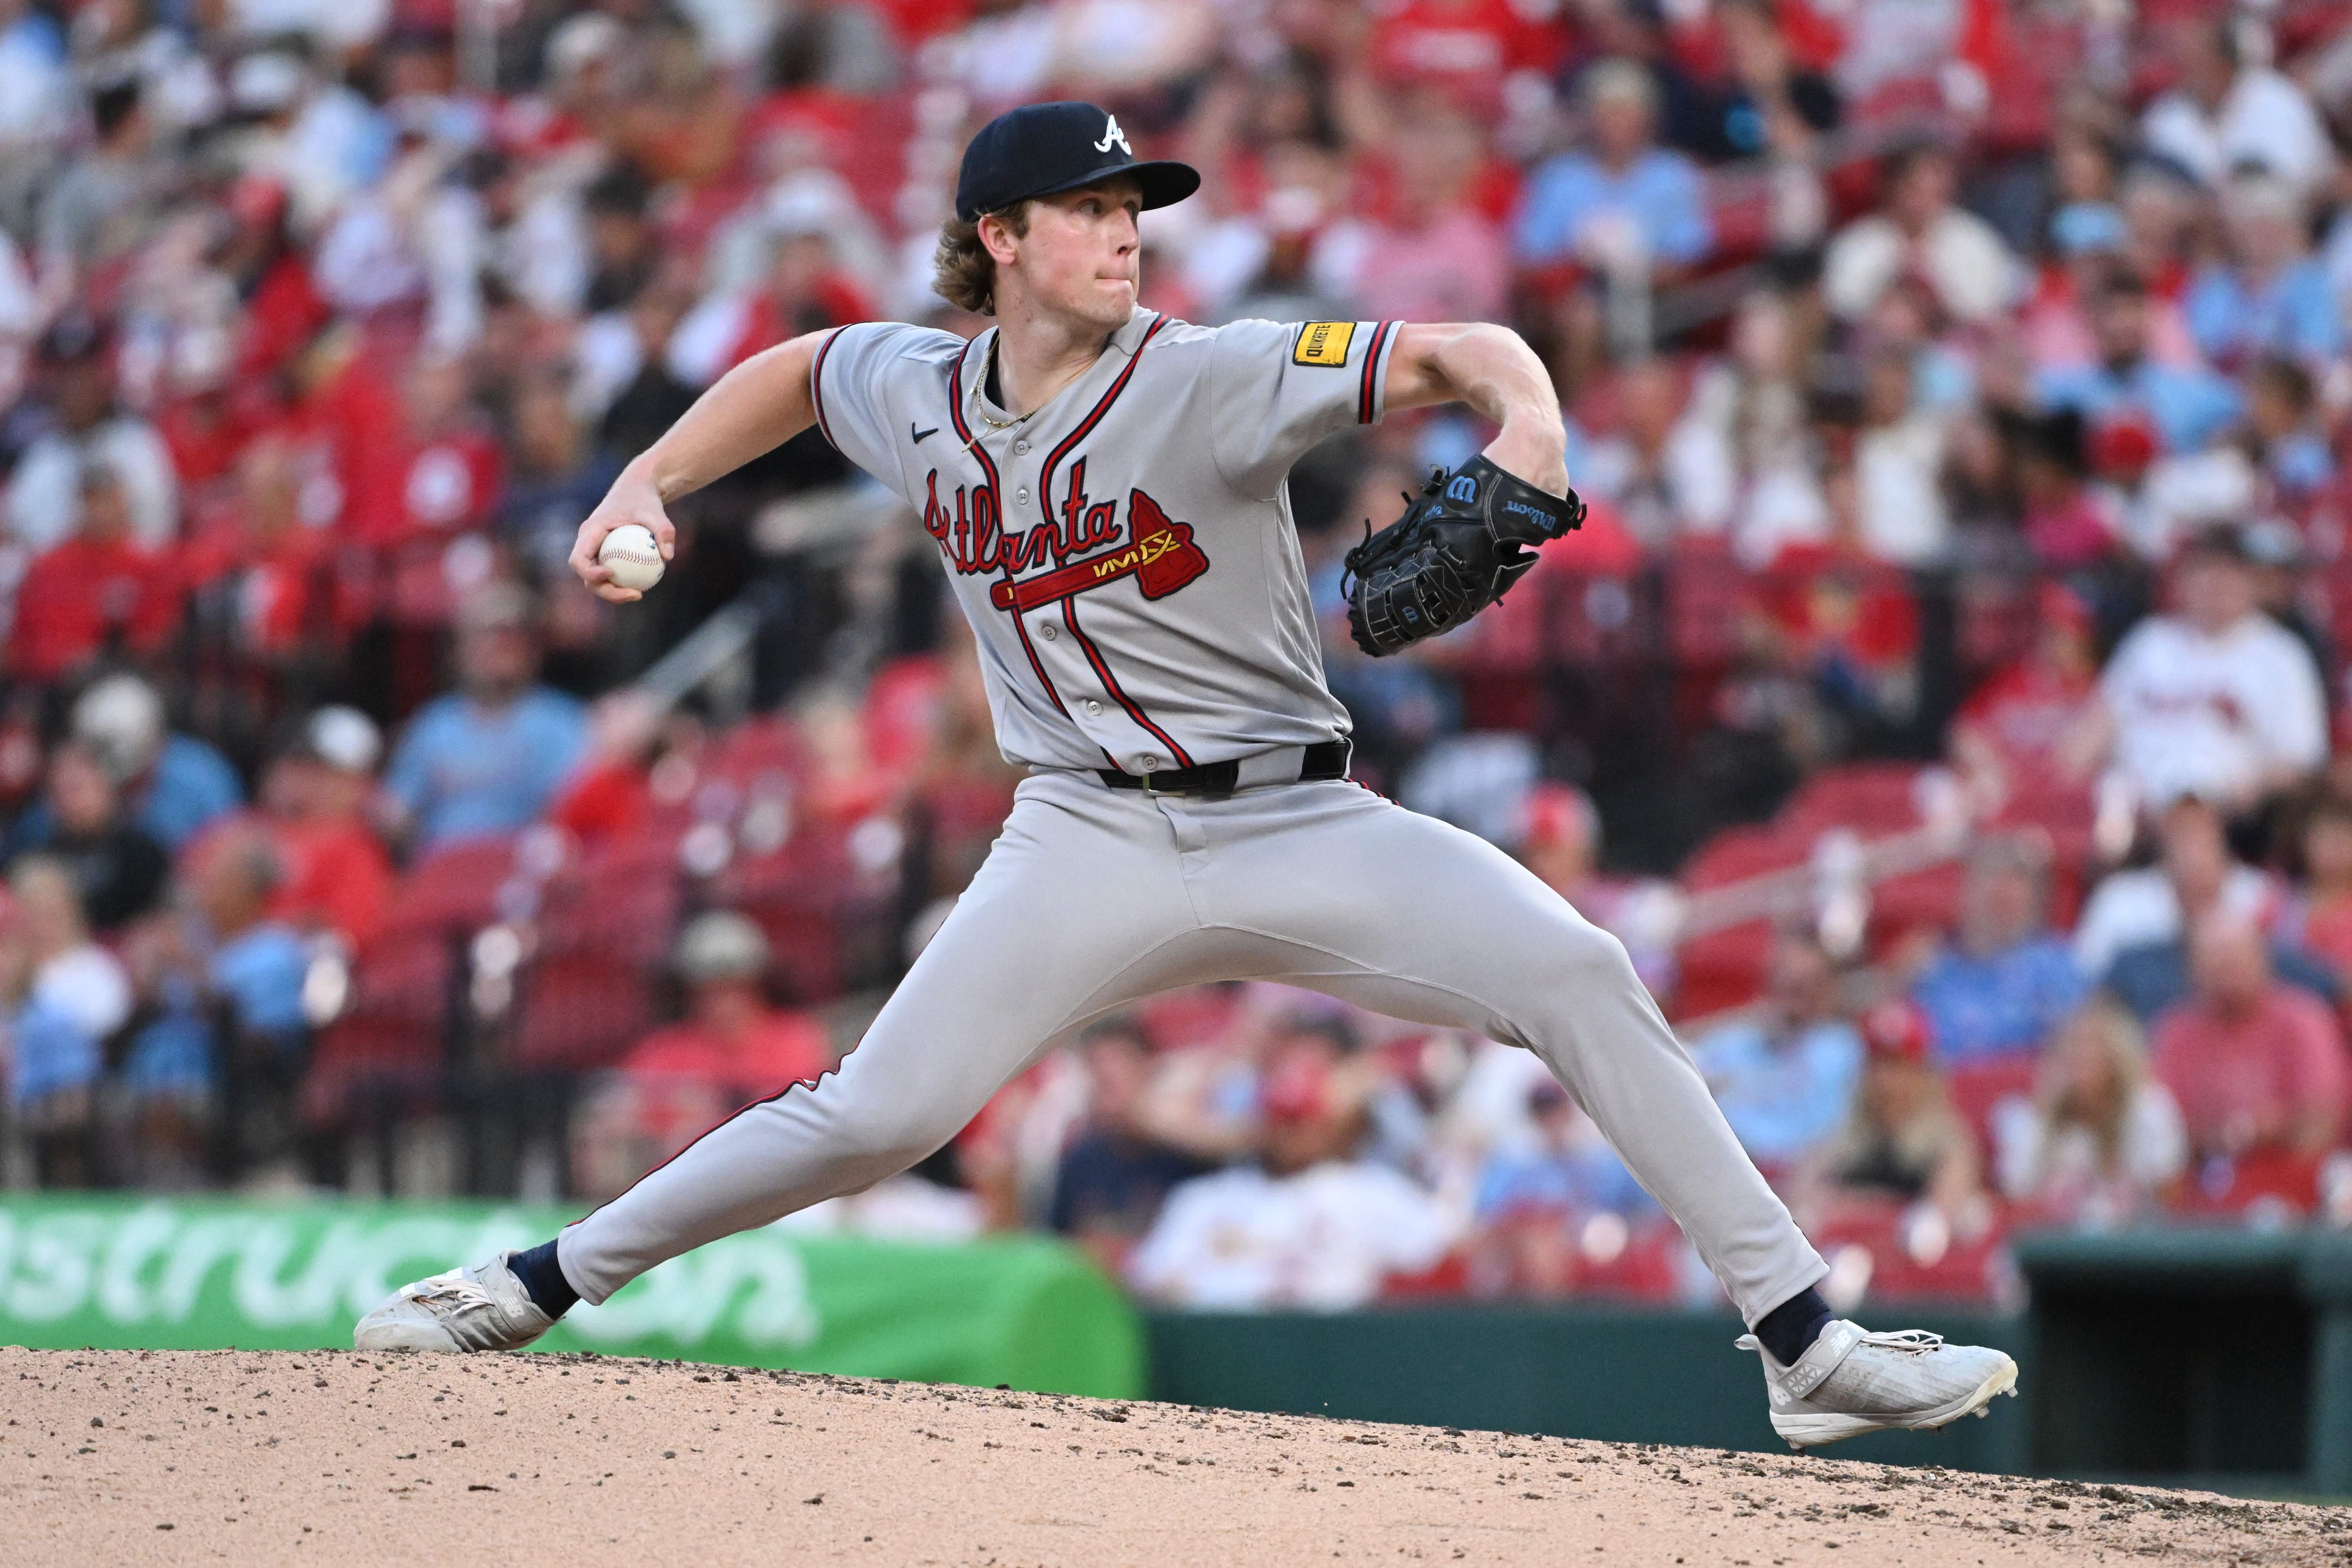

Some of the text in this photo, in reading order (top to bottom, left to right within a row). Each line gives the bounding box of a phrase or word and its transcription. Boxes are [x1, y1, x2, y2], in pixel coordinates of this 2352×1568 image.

[1094, 114, 1132, 155] A
[1306, 324, 1331, 357] QUIKRETE
[924, 455, 1123, 576] Atlanta
[1506, 500, 1556, 531] Wilson
